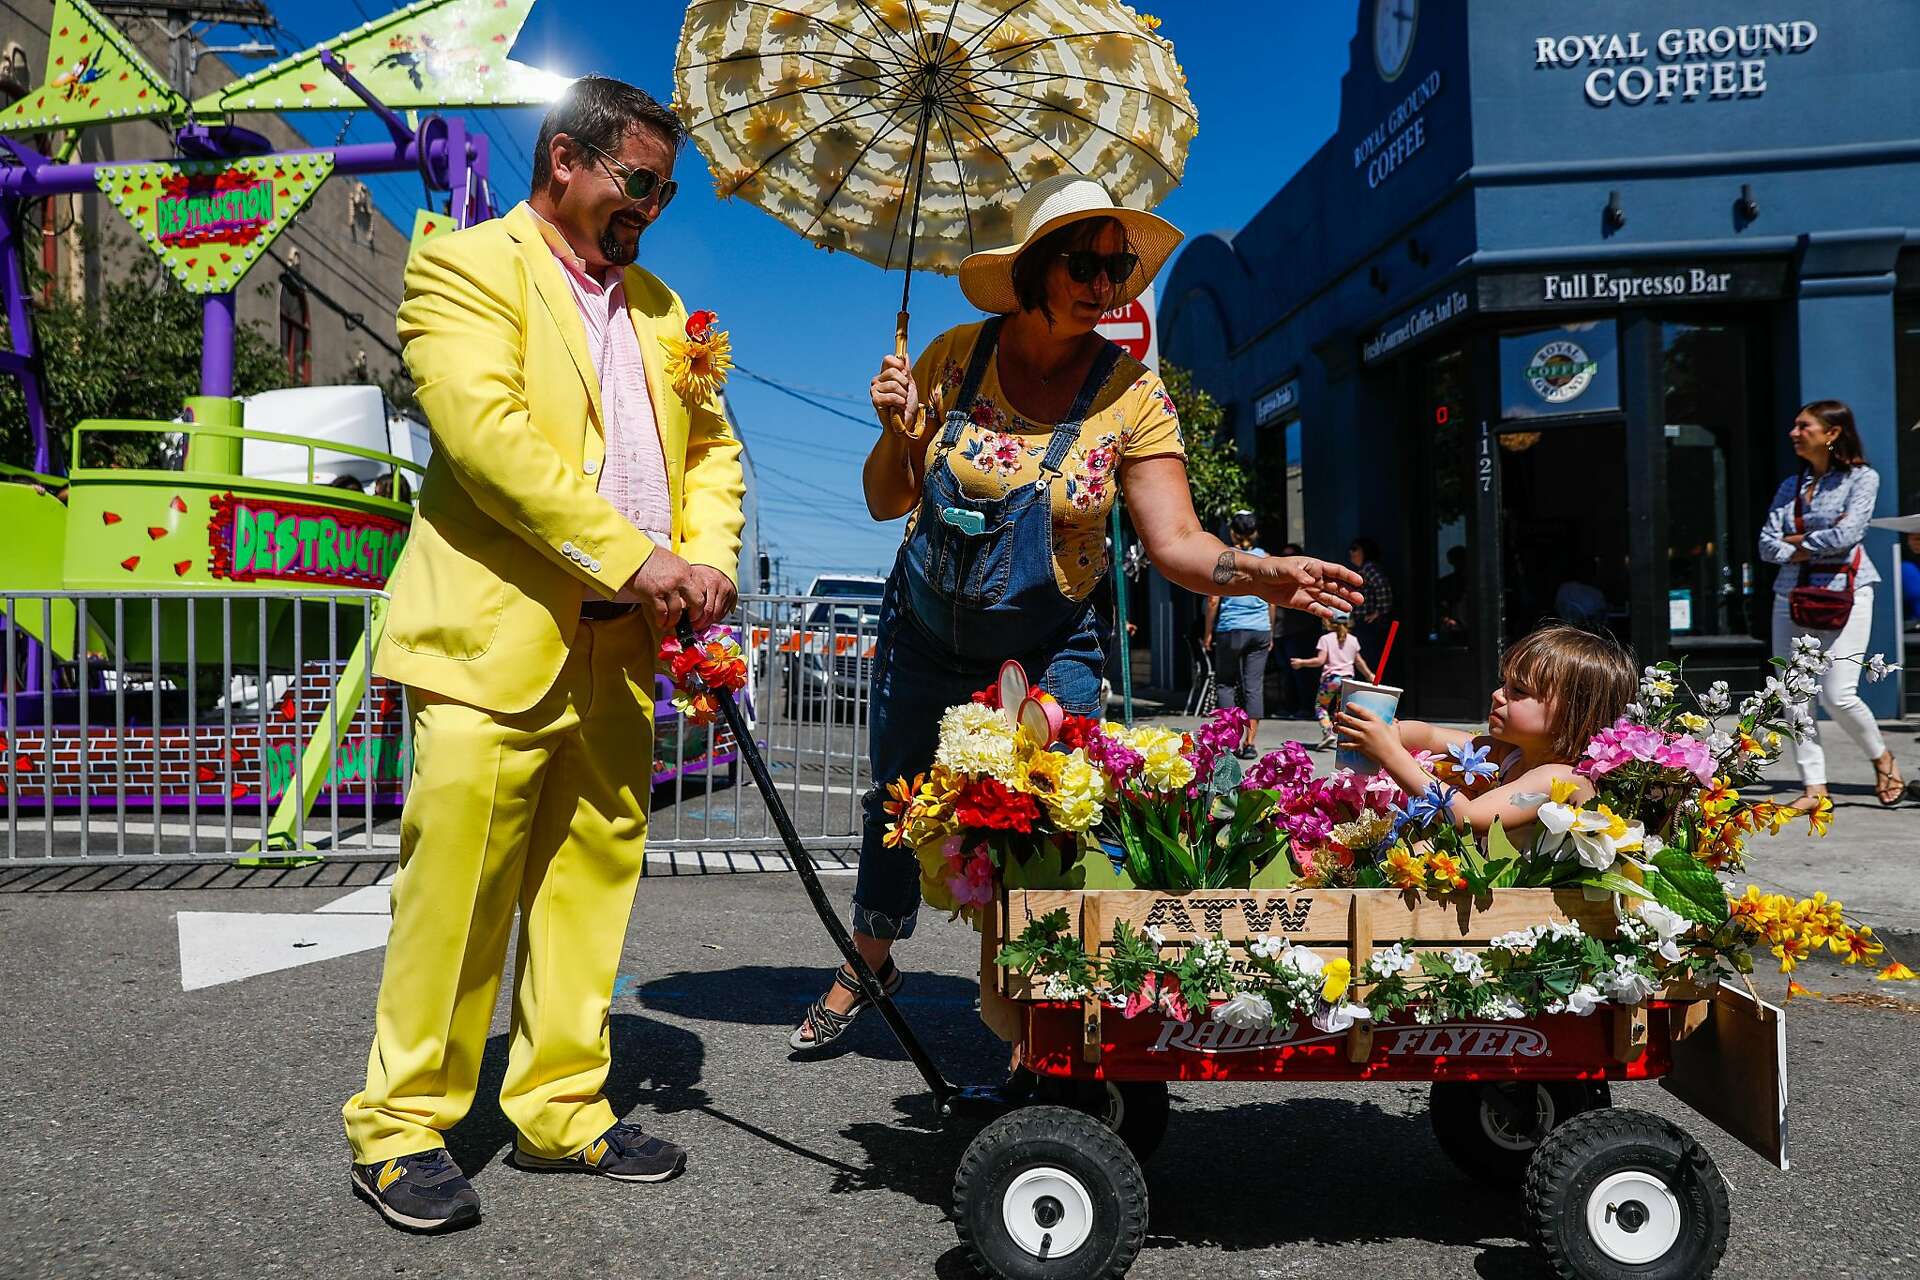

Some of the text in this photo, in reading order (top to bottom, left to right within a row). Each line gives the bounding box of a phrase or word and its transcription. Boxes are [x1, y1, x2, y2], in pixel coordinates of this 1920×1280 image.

[1535, 20, 1819, 64] ROYAL GROUND
[1584, 60, 1768, 102] COFFEE
[1353, 69, 1441, 169] ROYAL GROUND
[1368, 117, 1426, 189] COFFEE
[156, 180, 274, 241] DESTRUCTION
[1544, 268, 1732, 303] Full Espresso Bar
[1102, 303, 1132, 319] OT
[1409, 308, 1435, 337] Coffee
[1537, 343, 1580, 361] ROYAL
[1479, 421, 1492, 492] 1127
[232, 503, 409, 580] DESTRUCTIO
[1144, 898, 1314, 933] ATW
[1148, 1020, 1300, 1052] RADIO
[1388, 1027, 1546, 1057] FLYER
